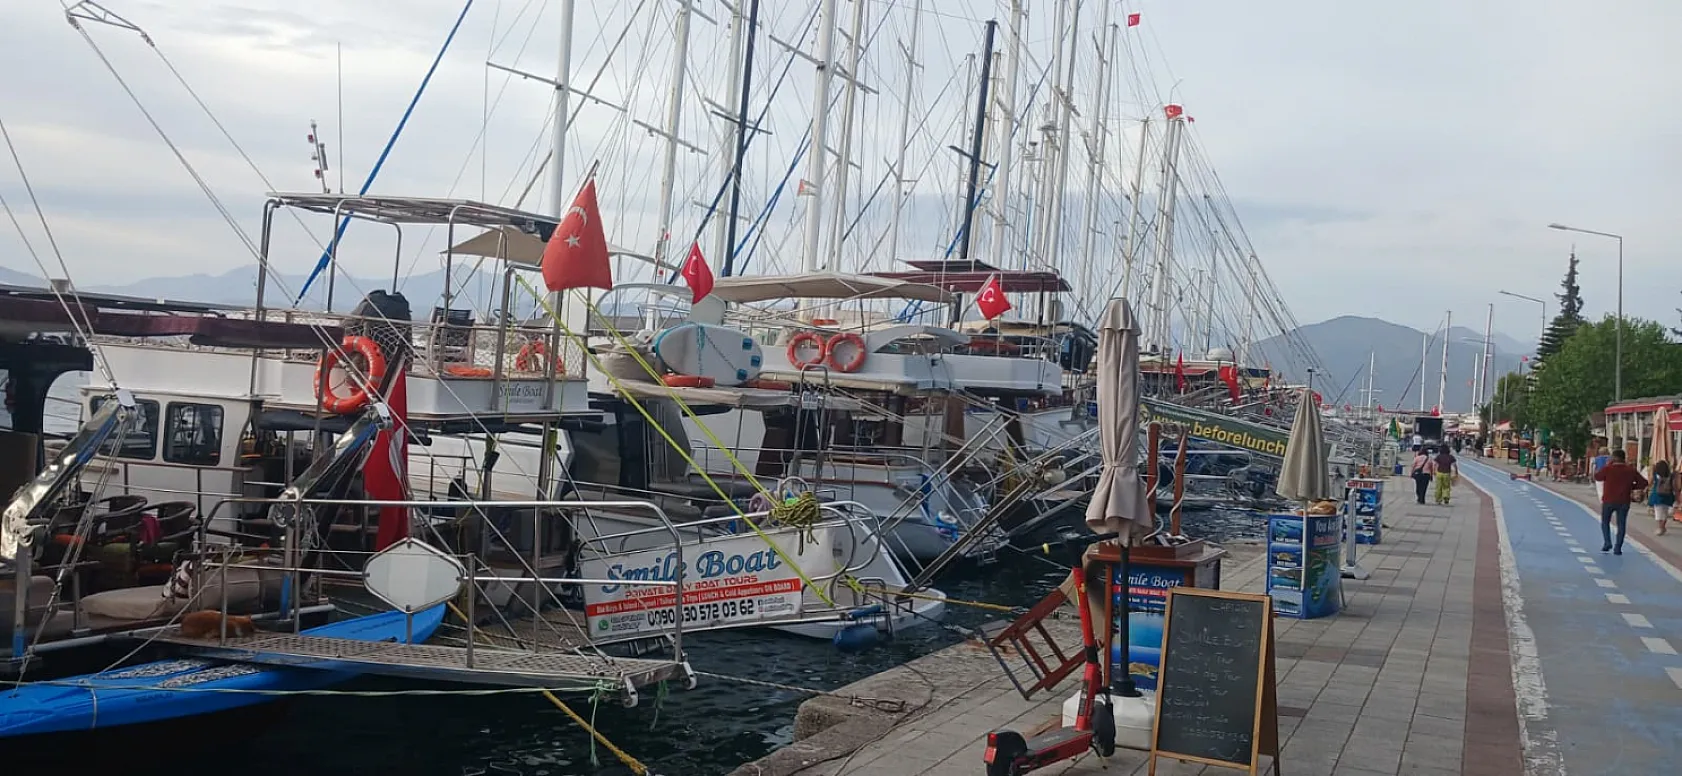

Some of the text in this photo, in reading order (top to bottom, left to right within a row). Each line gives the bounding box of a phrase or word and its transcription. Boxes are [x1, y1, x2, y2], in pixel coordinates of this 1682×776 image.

[696, 547, 782, 578] Boat
[625, 575, 758, 598] PRIVATE DALY BOAT TOURS
[678, 605, 697, 622] 30
[699, 603, 719, 620] 572
[722, 601, 737, 617] 03
[739, 599, 755, 615] 62
